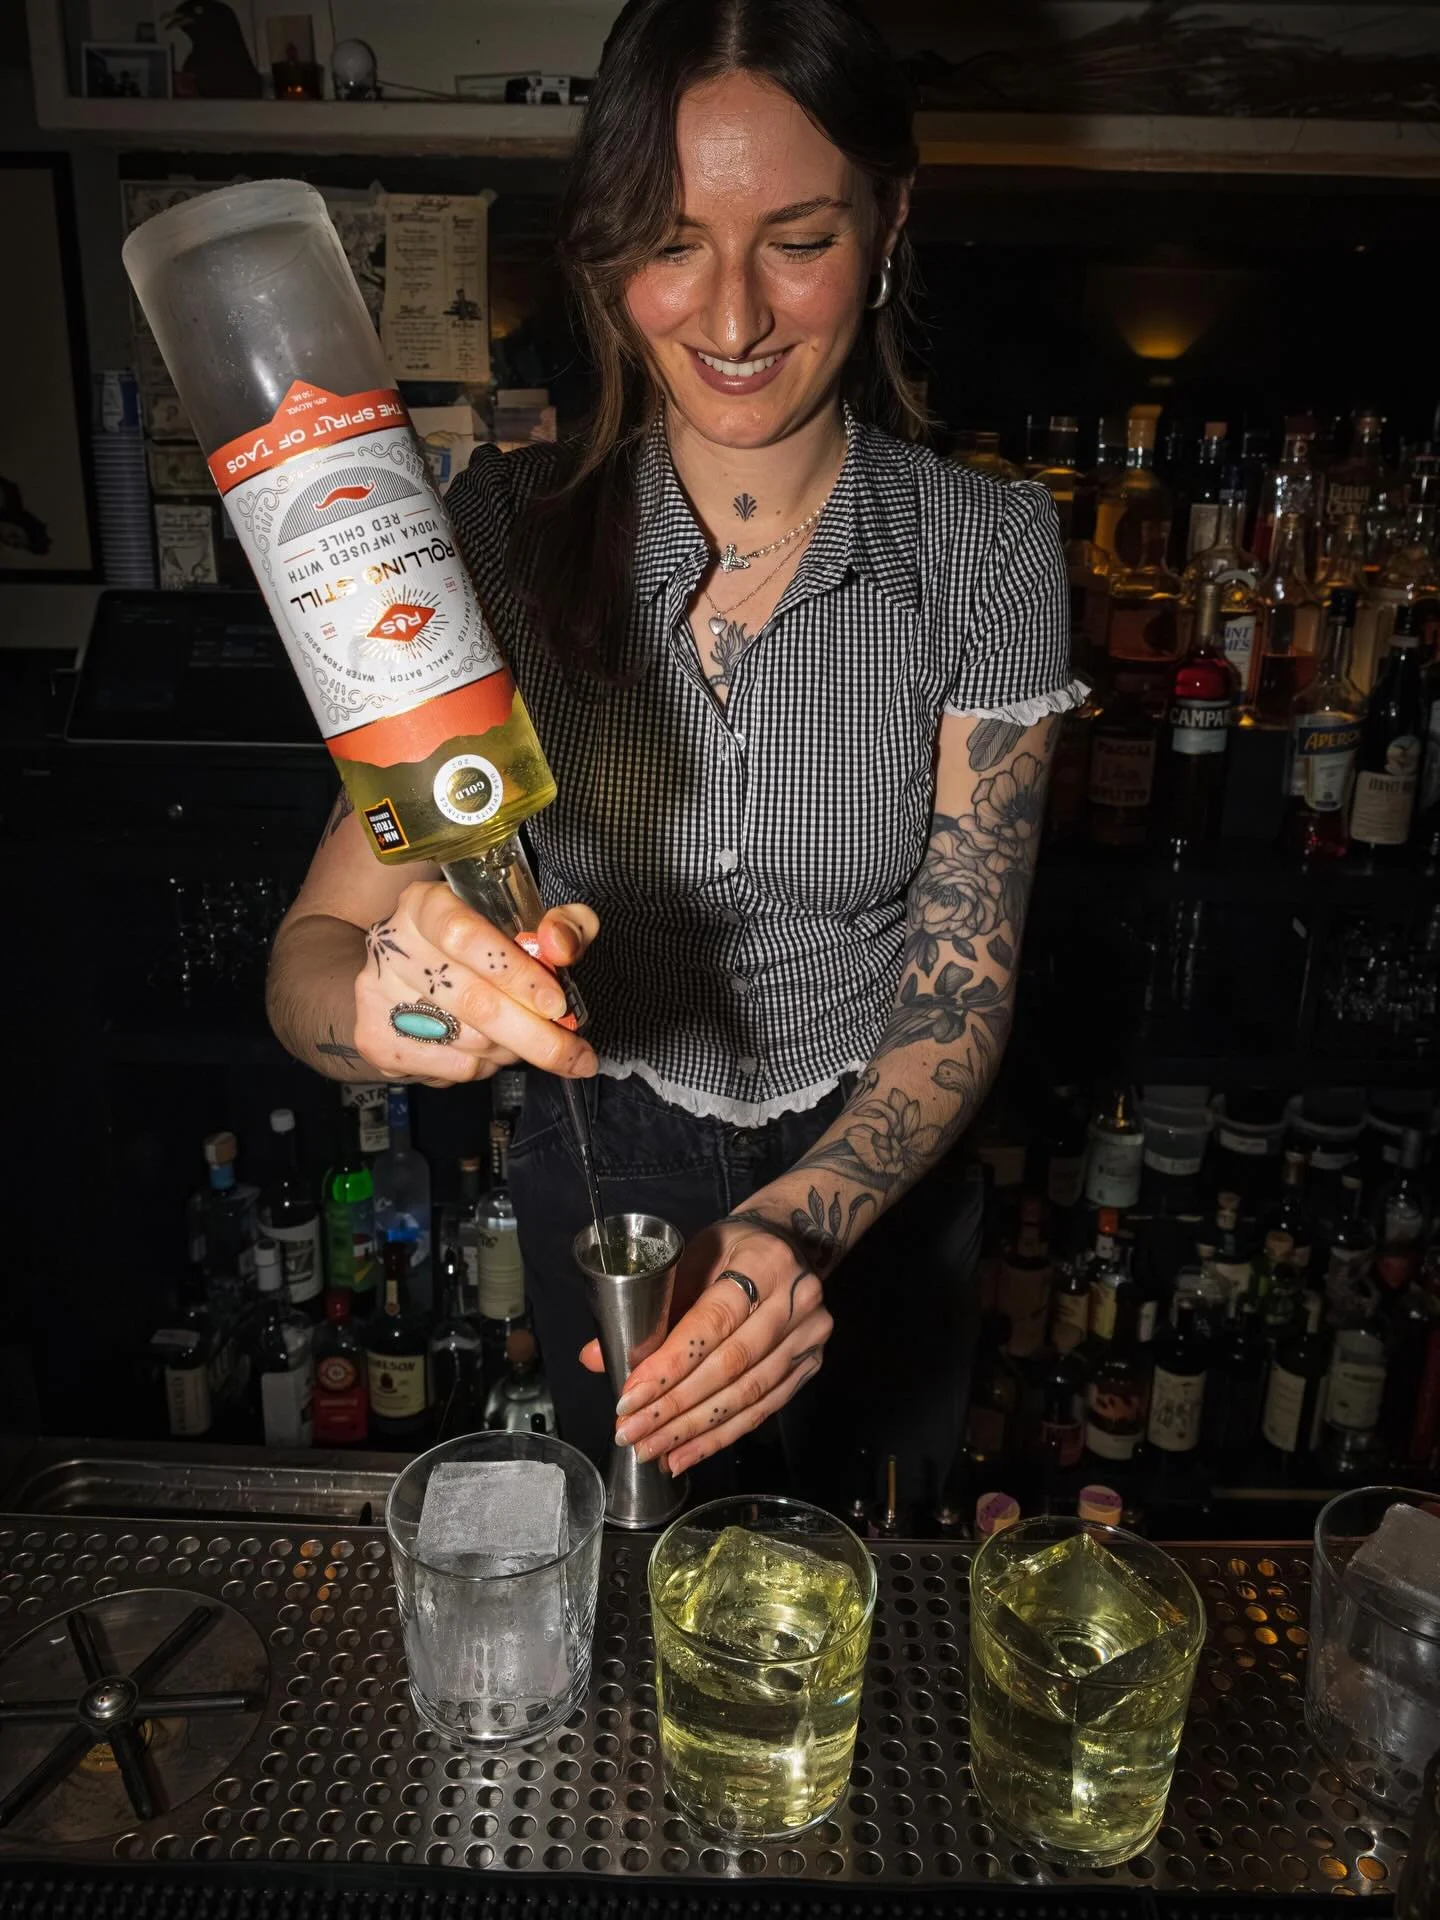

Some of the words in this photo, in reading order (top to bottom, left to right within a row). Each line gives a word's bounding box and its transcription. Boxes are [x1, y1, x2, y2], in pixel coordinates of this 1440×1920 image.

[312, 406, 376, 437] SPIRIT
[377, 402, 403, 419] THE
[277, 428, 306, 449] OF
[225, 438, 274, 474] TAOS
[371, 513, 401, 531] RED
[400, 519, 439, 539] VODKA
[317, 525, 364, 552] CHILE
[329, 532, 396, 566] INFUSED
[287, 560, 325, 584] WITH
[366, 538, 456, 586] ROLLING
[290, 577, 357, 612] STILL
[457, 601, 471, 642] CRAFTED
[322, 653, 343, 672] FROM
[425, 648, 454, 671] SMALL
[345, 668, 375, 683] WATER
[389, 669, 422, 683] BATCH
[455, 781, 486, 801] GOLD
[439, 797, 472, 821] RATINGS
[475, 793, 500, 820] SPIRITS
[372, 819, 395, 834] TRUE
